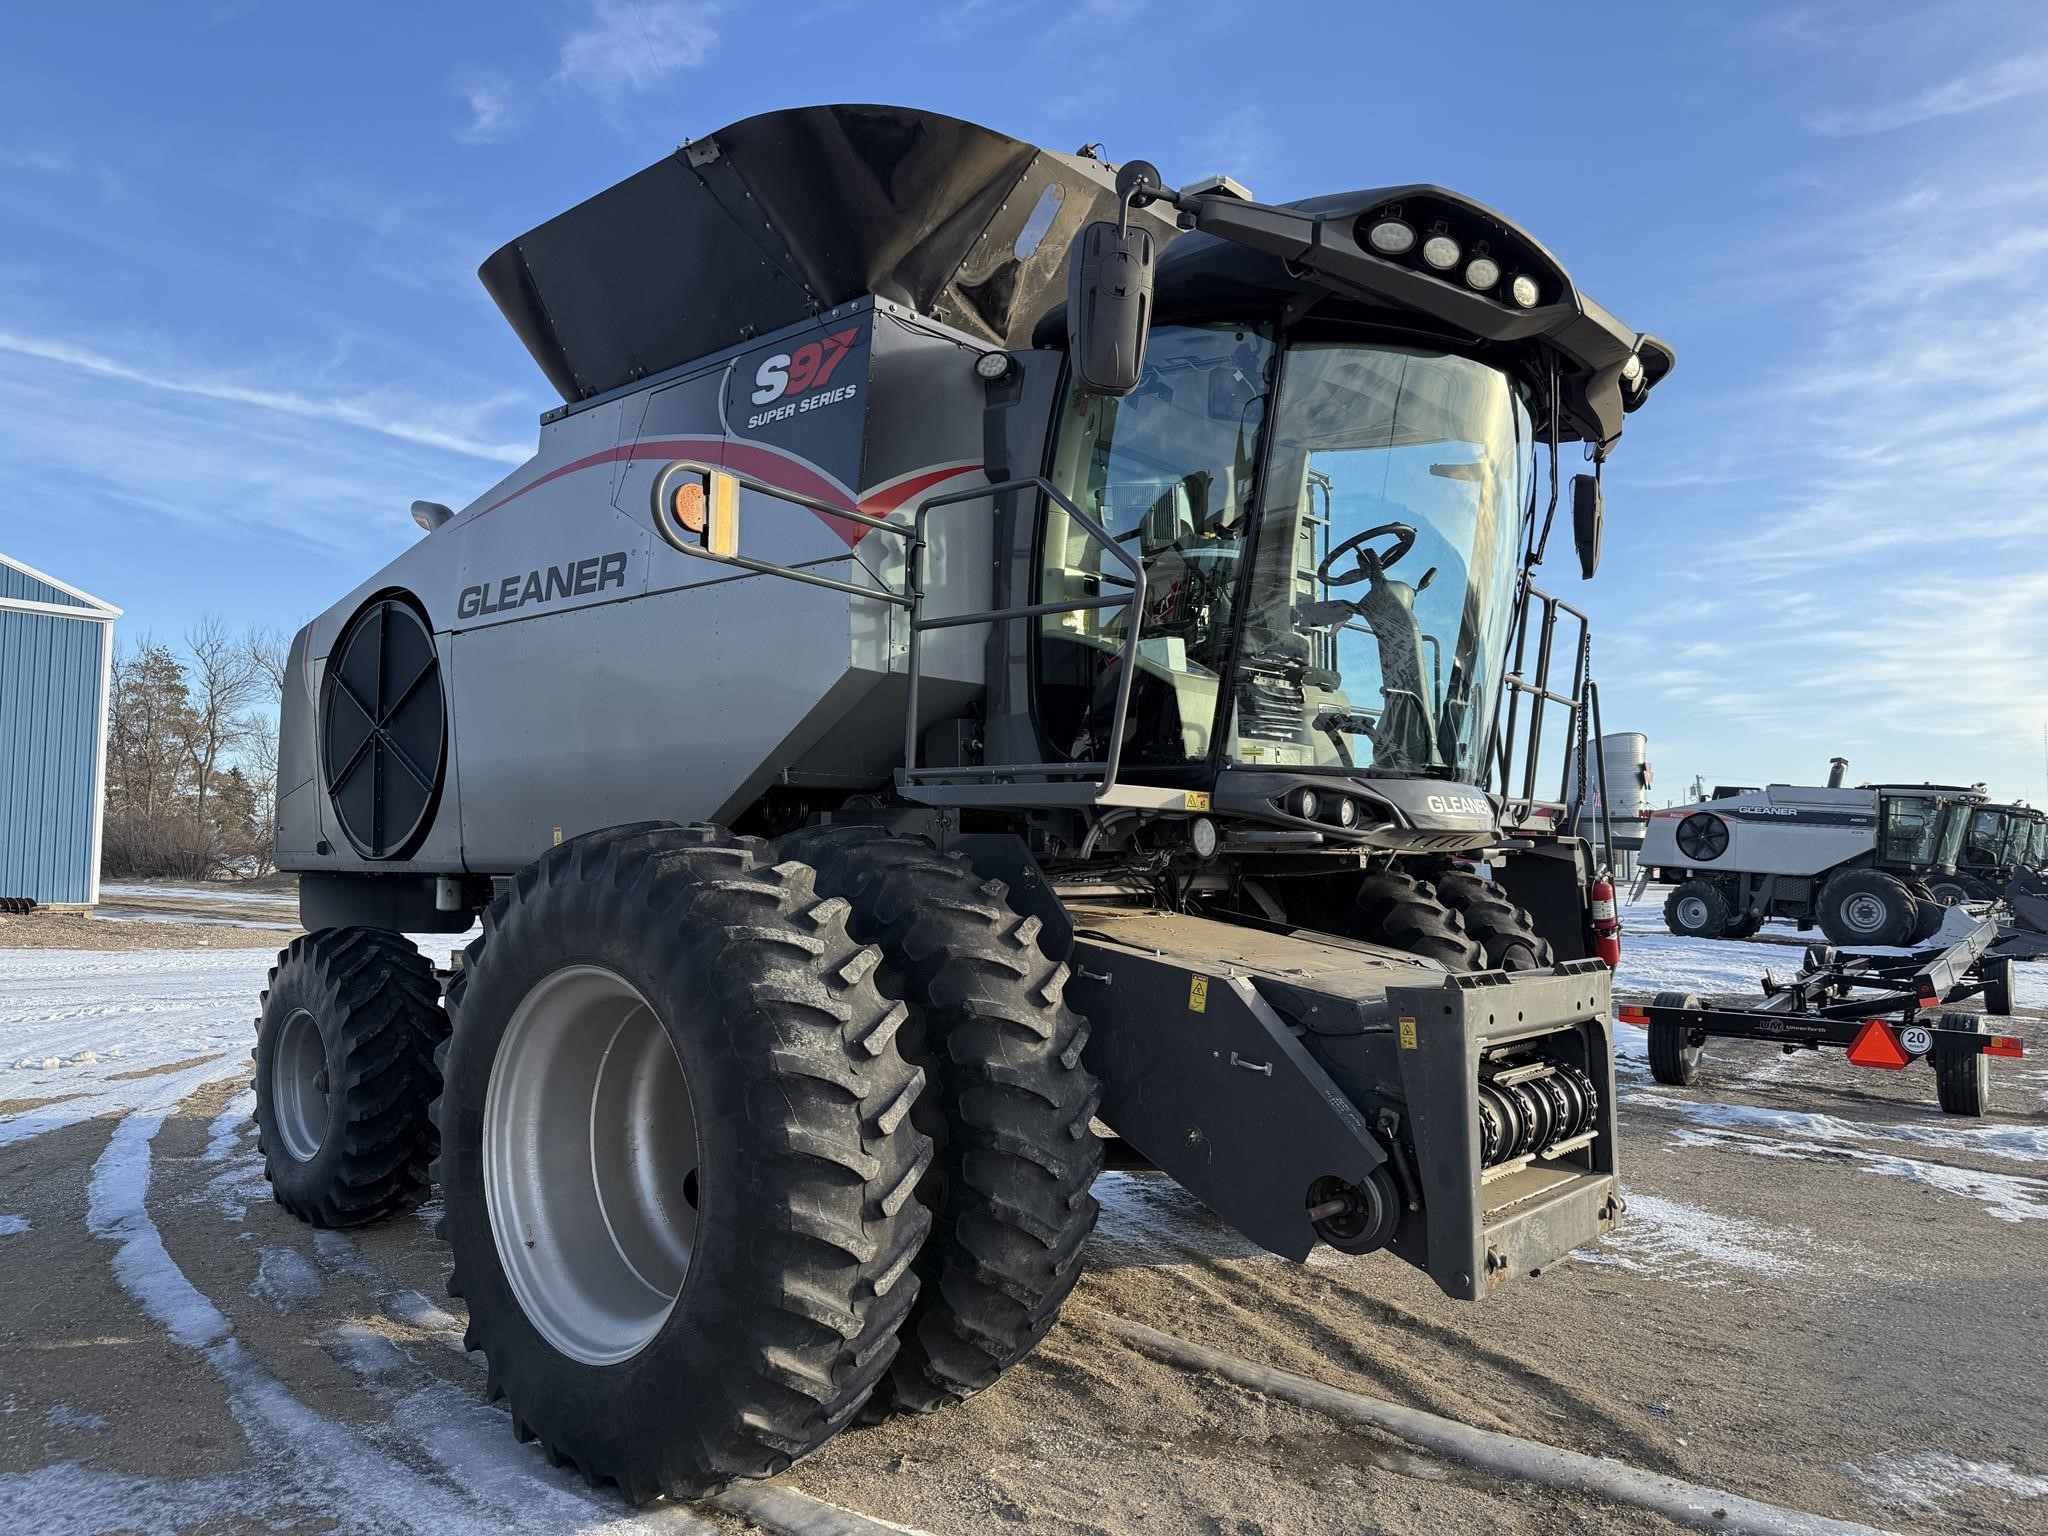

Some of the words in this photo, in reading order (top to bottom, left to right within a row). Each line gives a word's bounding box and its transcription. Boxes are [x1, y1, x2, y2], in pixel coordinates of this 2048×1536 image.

[752, 326, 860, 404] S97
[747, 402, 796, 429] SUPER
[799, 384, 857, 413] SERIES
[457, 551, 628, 620] GLEANER
[1427, 795, 1489, 814] GLEANER
[1738, 806, 1798, 816] GLEANER
[1907, 1031, 1925, 1043] 20
